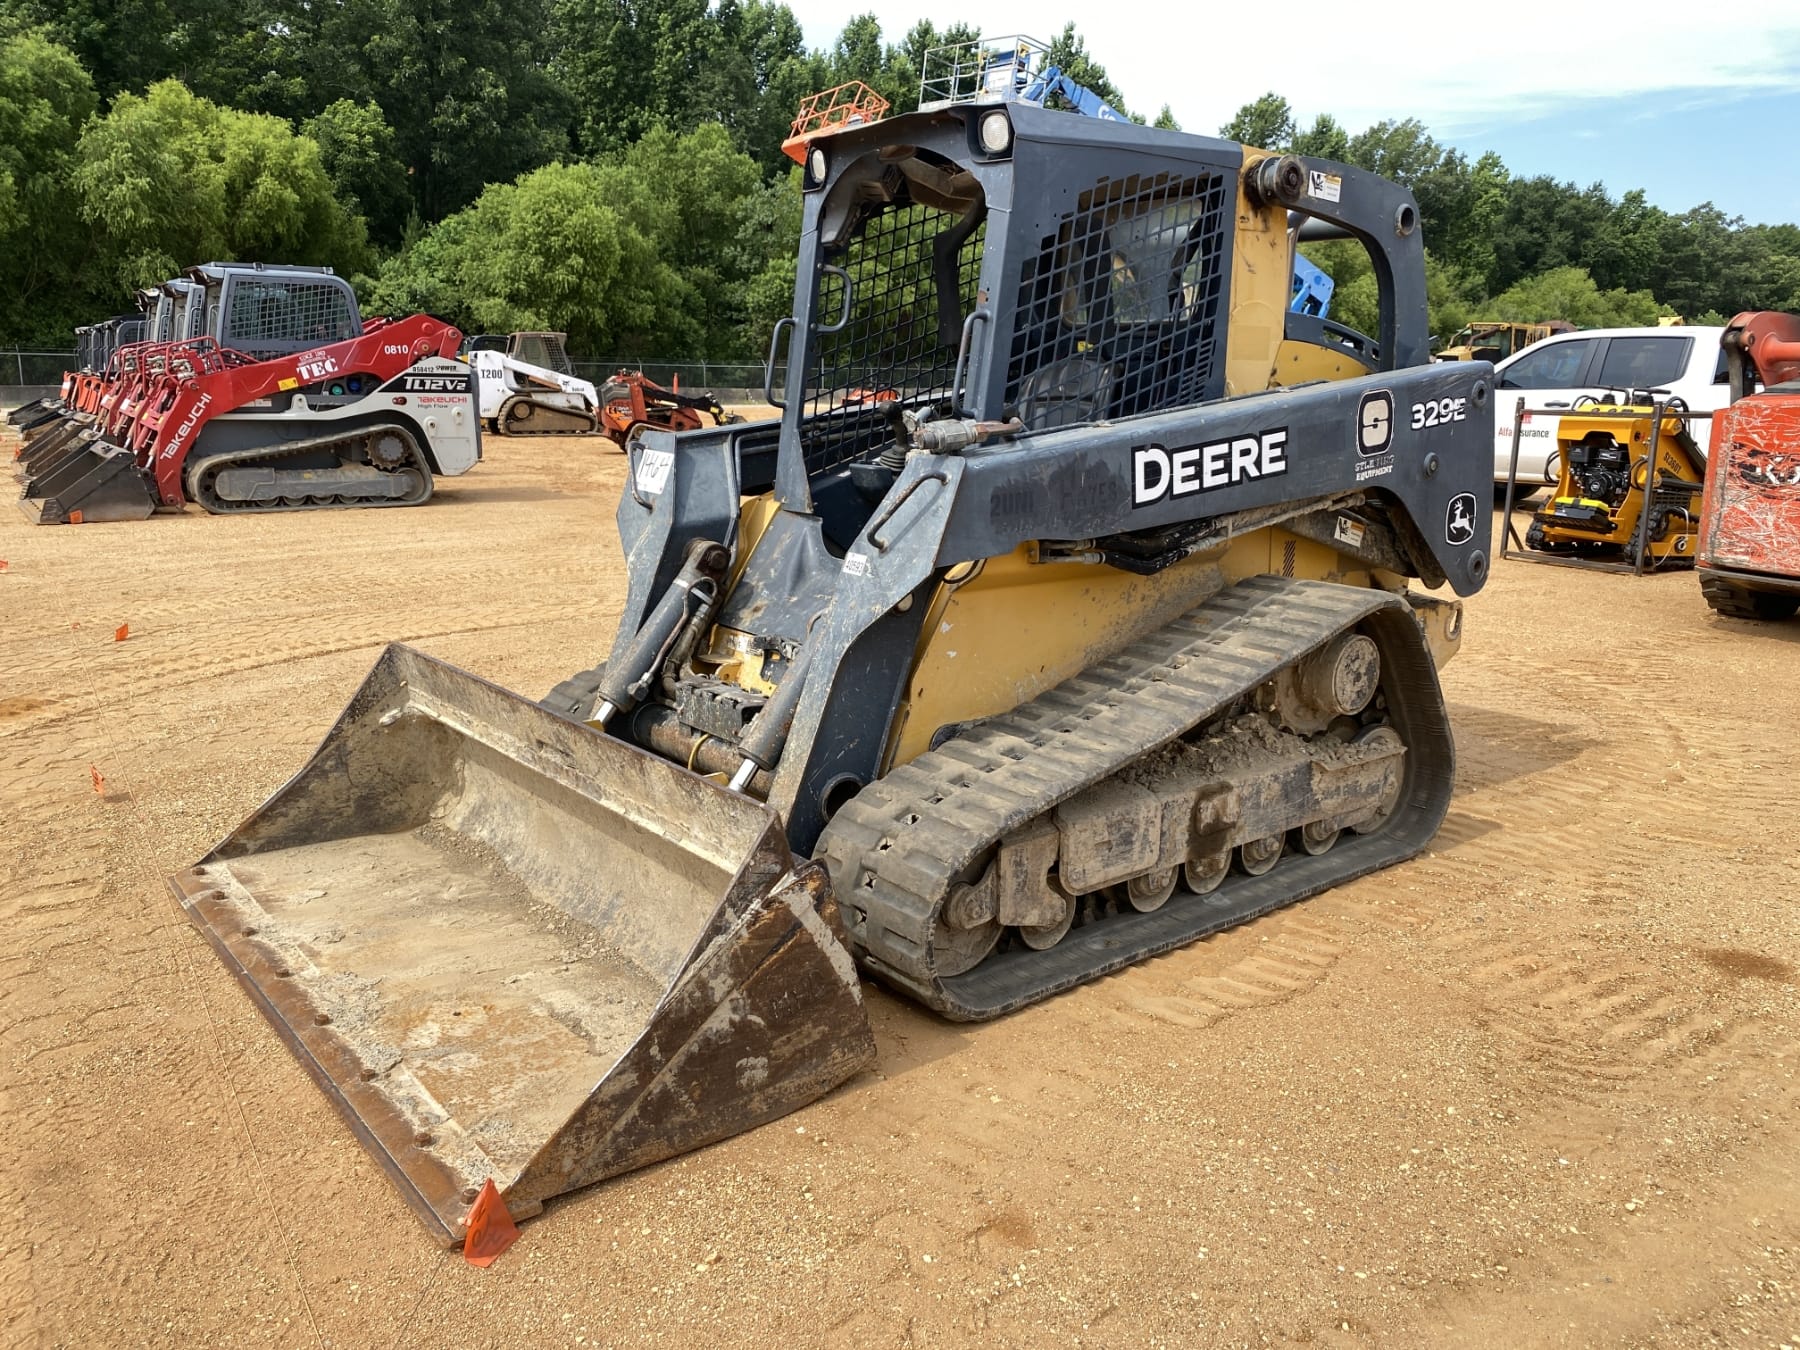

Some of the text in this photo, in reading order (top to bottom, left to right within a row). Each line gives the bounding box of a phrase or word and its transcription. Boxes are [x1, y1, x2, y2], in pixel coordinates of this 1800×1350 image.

[384, 345, 408, 354] 0810
[296, 357, 338, 380] TEC
[480, 369, 503, 378] T200
[417, 396, 467, 404] TAKEUCHI
[1411, 398, 1466, 429] 329E
[160, 393, 212, 459] TAKEUCHI
[1498, 427, 1550, 438] Alfa surance
[1134, 431, 1287, 504] DEERE
